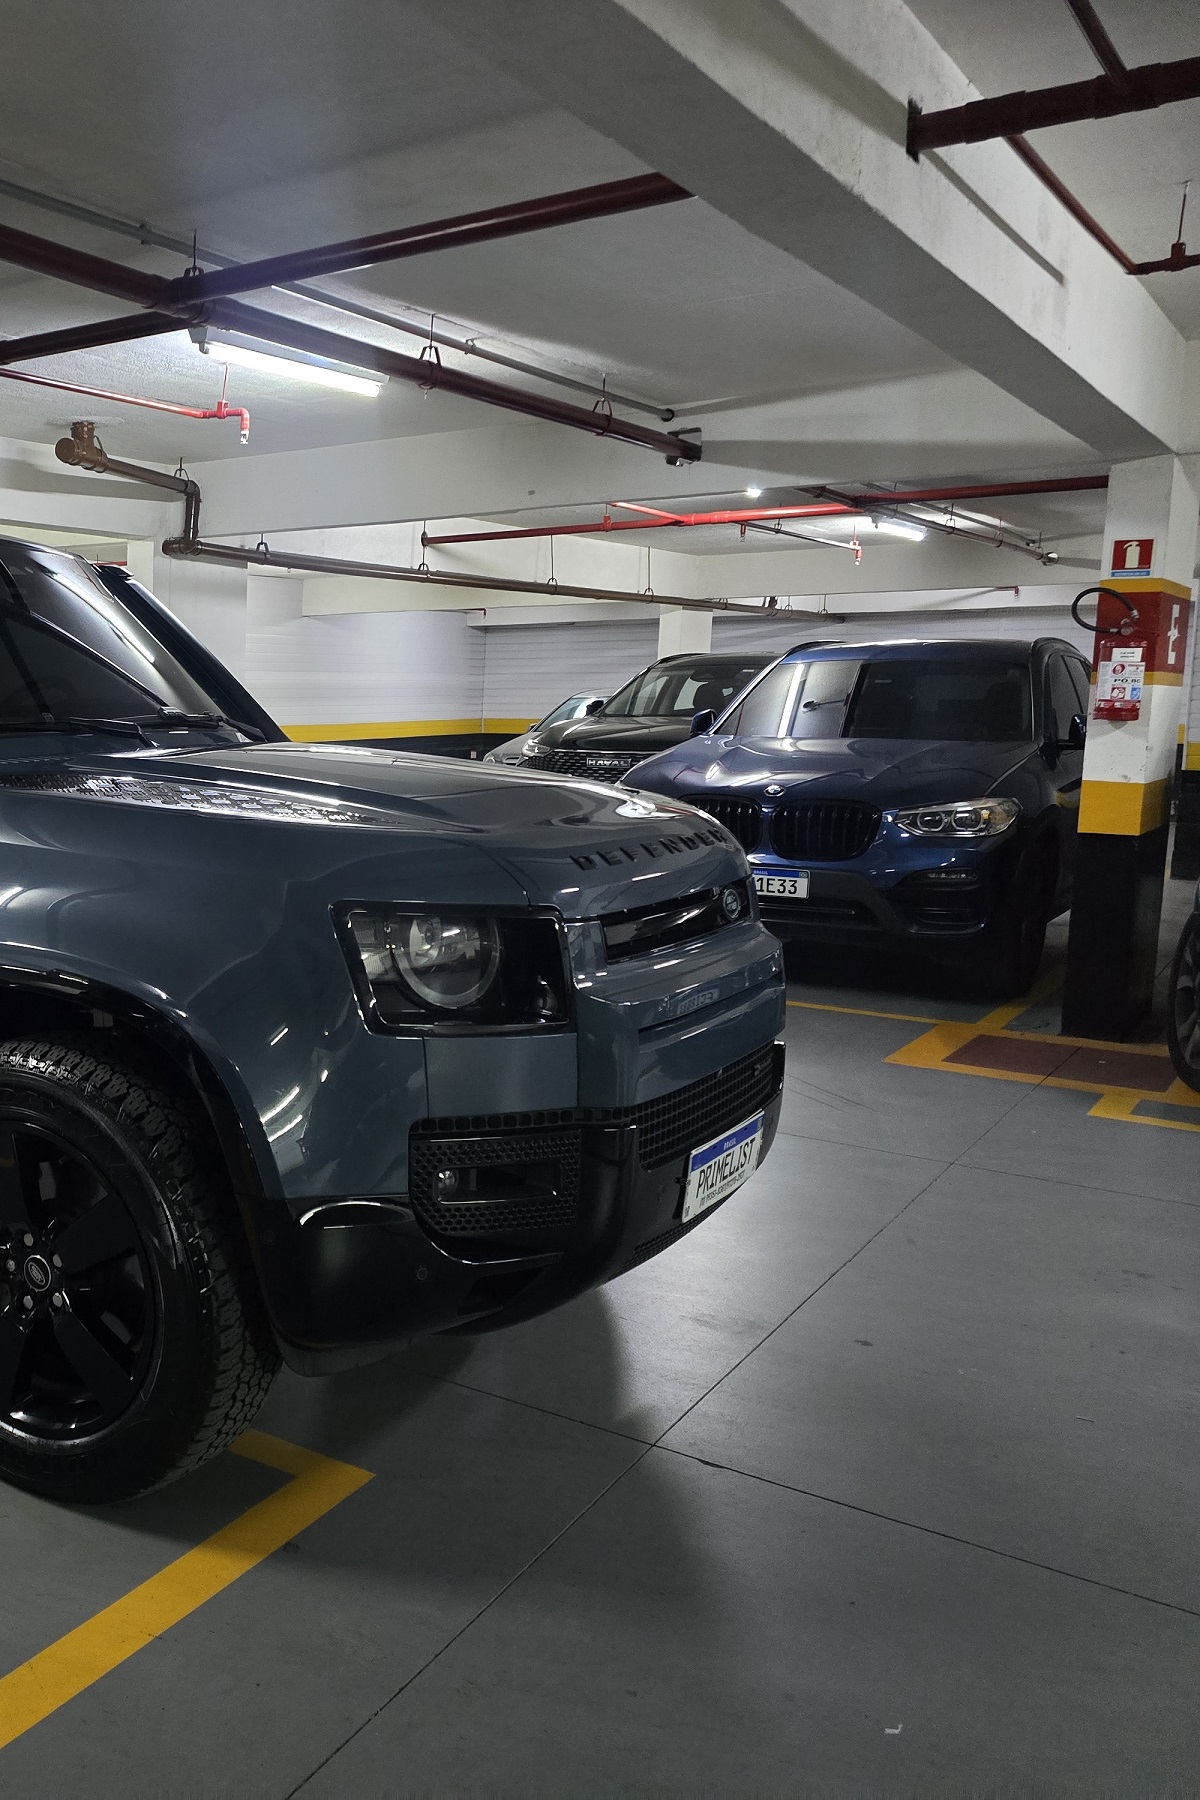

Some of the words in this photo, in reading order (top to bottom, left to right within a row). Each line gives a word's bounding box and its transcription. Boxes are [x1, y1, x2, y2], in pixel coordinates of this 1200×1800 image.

[588, 759, 628, 767] HAVAL
[569, 829, 728, 871] DEFENDER
[756, 877, 797, 895] 1E33
[695, 1136, 756, 1199] PRIMELIST
